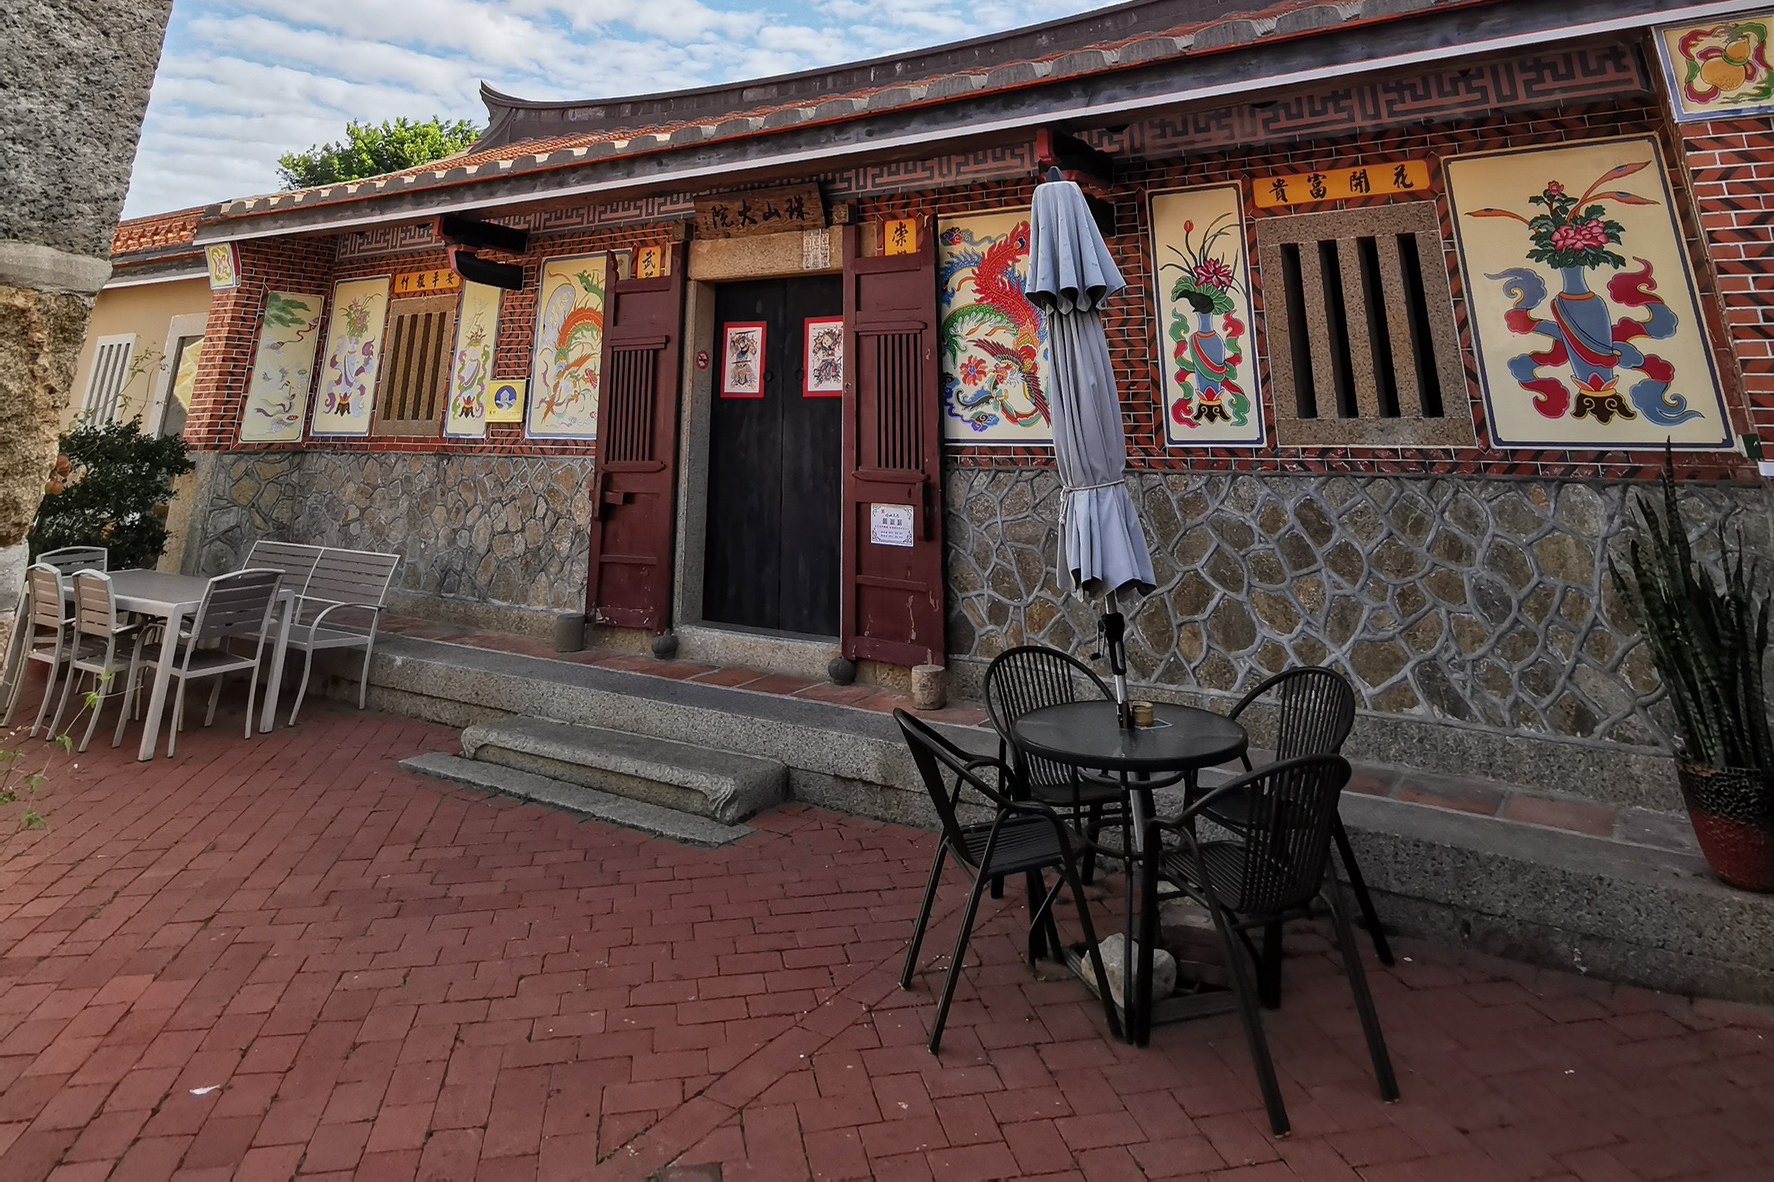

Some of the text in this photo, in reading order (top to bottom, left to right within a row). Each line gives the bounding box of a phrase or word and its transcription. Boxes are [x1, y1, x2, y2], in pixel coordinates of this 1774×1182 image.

[1269, 164, 1415, 203] 花開富貴
[710, 193, 812, 230] 珠山大院
[401, 270, 455, 291] 竹報平安
